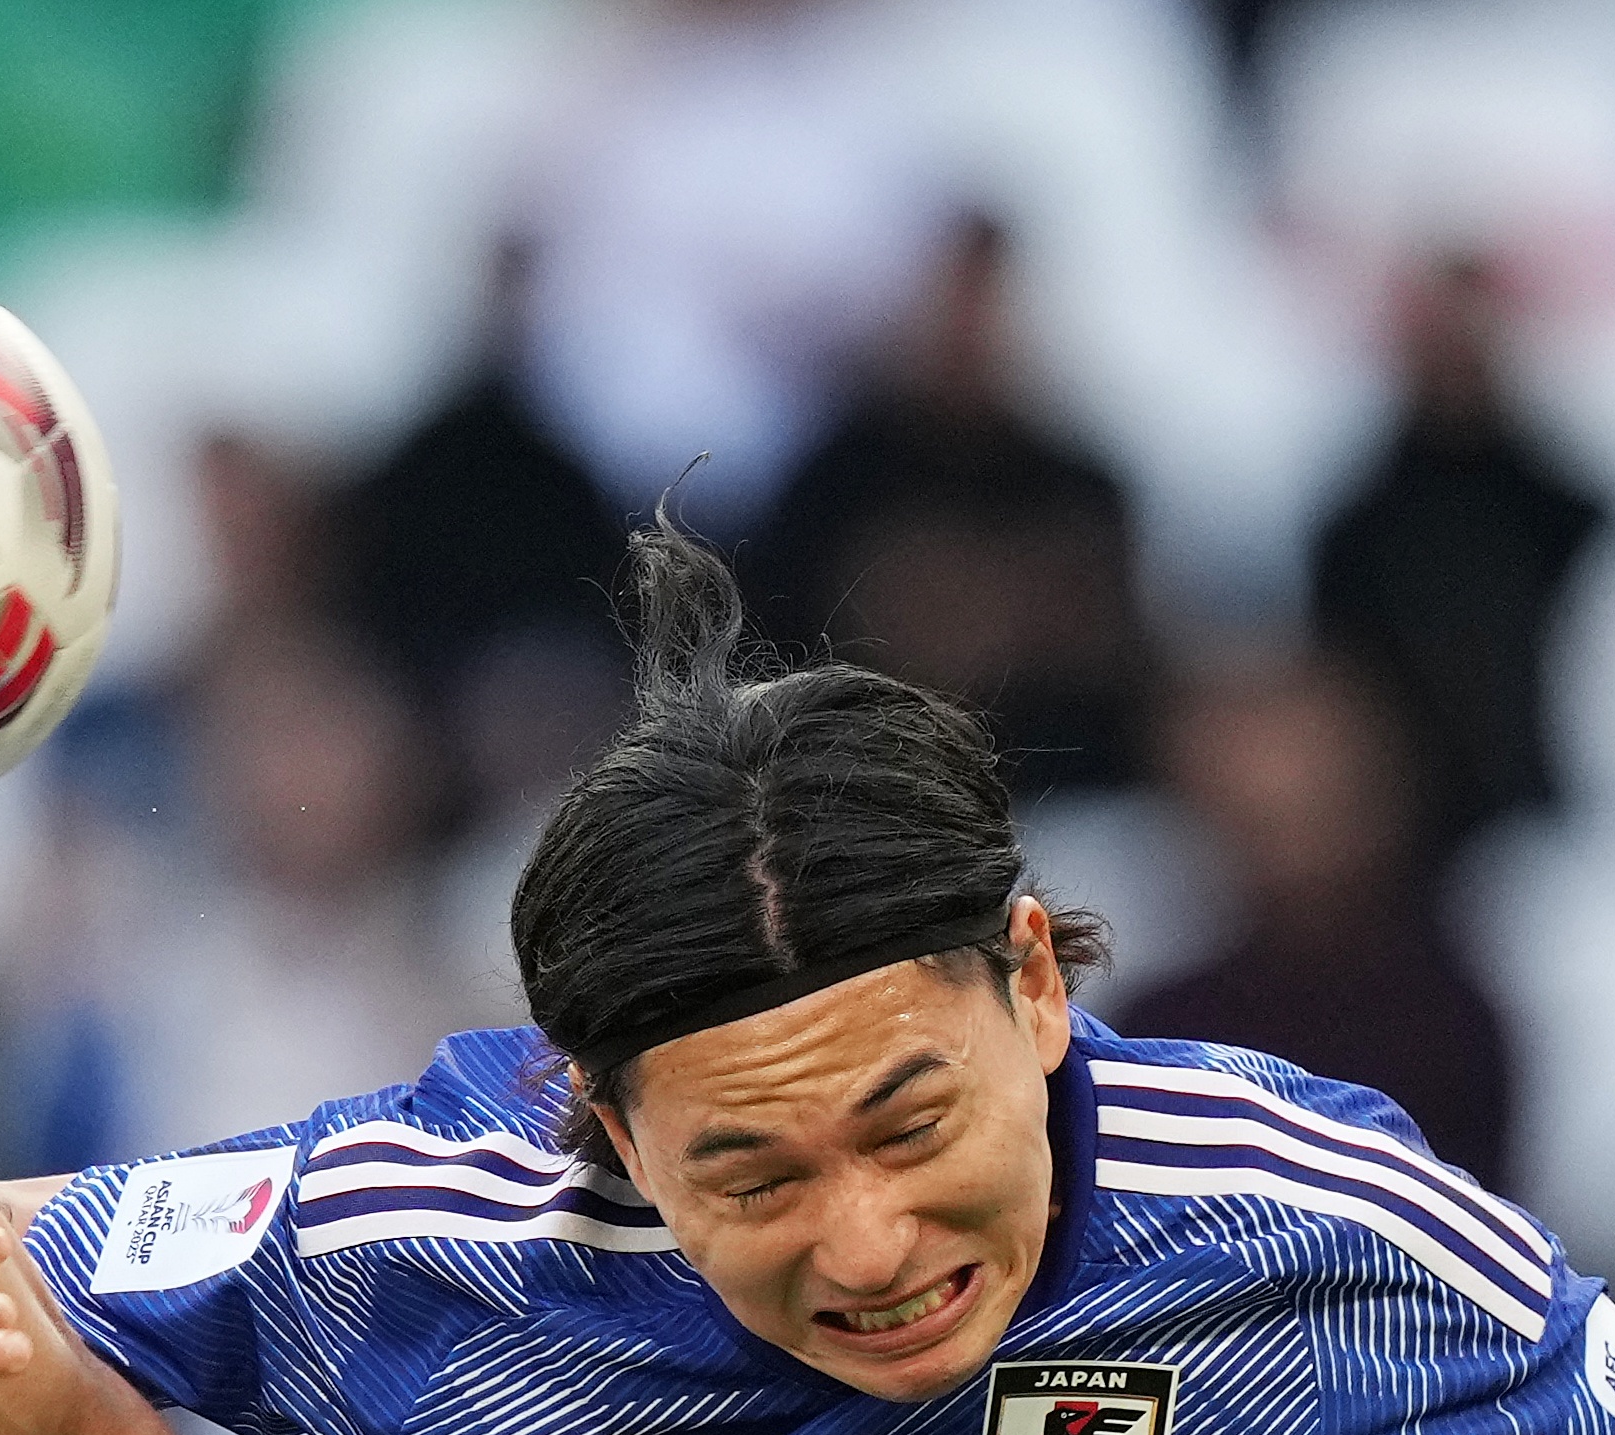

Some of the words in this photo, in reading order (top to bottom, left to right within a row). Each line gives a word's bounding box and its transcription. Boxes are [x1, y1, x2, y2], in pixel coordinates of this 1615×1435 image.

[136, 1185, 158, 1227] QATAR
[147, 1180, 172, 1228] ASIAN
[161, 1207, 175, 1231] AFC
[138, 1231, 156, 1264] CUP
[1034, 1371, 1128, 1388] JAPAN
